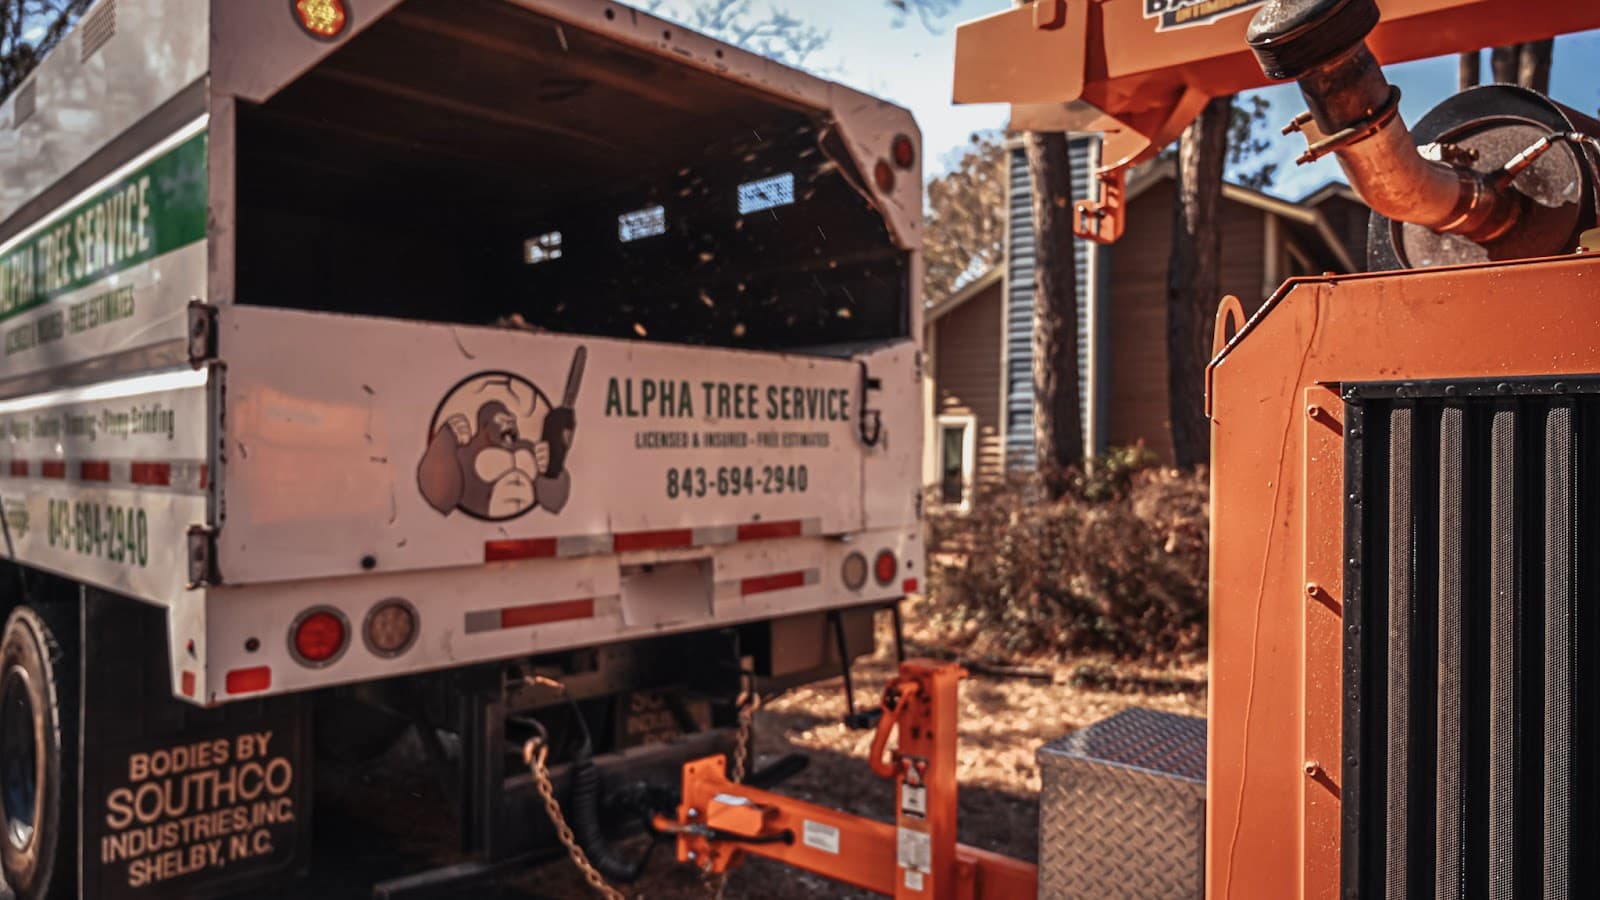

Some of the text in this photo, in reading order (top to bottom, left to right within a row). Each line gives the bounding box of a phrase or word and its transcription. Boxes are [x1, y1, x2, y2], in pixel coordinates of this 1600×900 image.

[38, 221, 71, 294] TREE
[74, 177, 150, 279] SERVICE
[131, 403, 175, 440] Grinding
[605, 376, 850, 422] ALPHA TREE SERVICE
[635, 431, 689, 449] LICENSED
[703, 431, 748, 449] INSURED
[757, 431, 779, 449] FREE
[666, 464, 808, 500] 843-694-2940
[129, 731, 273, 782] BODIES BY
[106, 756, 293, 830] SOUTHCO
[128, 840, 226, 888] SHELBY,
